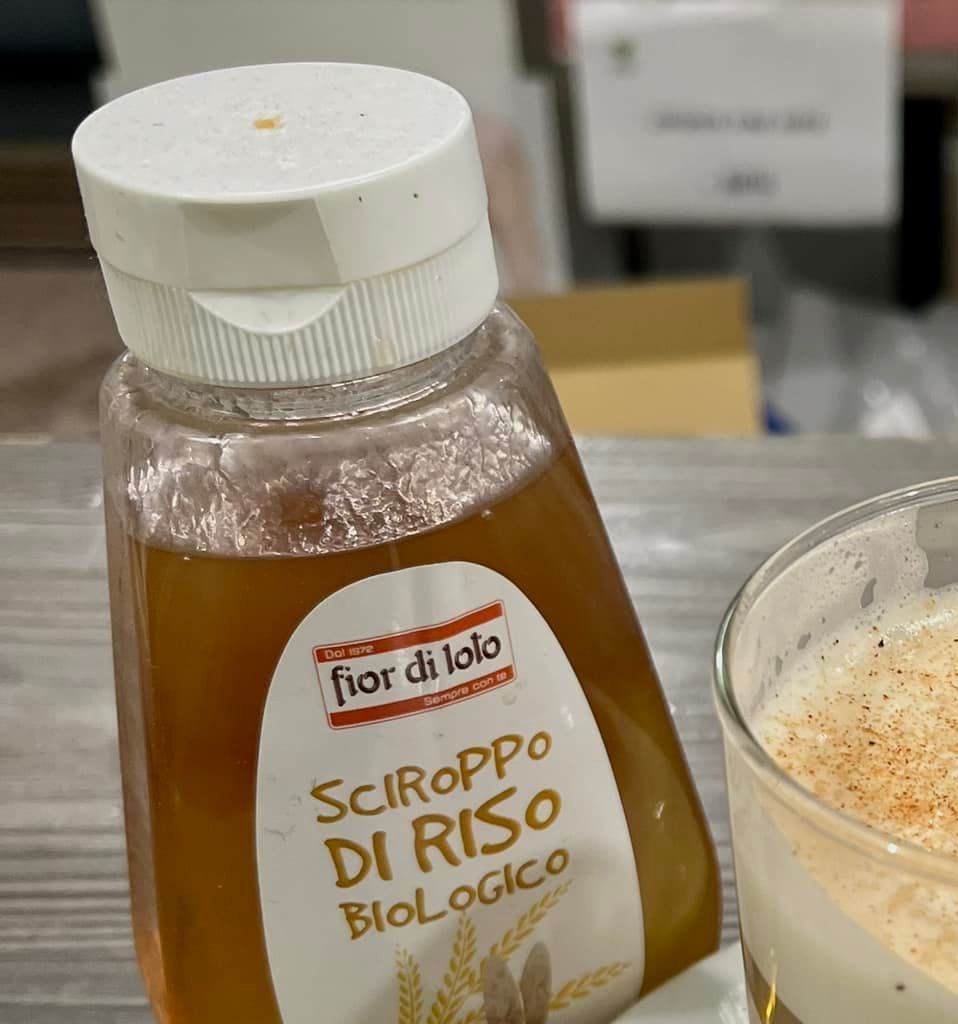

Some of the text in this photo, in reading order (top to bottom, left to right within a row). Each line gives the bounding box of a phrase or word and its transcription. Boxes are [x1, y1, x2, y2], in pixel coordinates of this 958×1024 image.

[325, 647, 345, 660] Dal
[331, 631, 501, 707] fior di loto
[424, 671, 507, 706] Sempre con te
[324, 786, 561, 888] DI RISO
